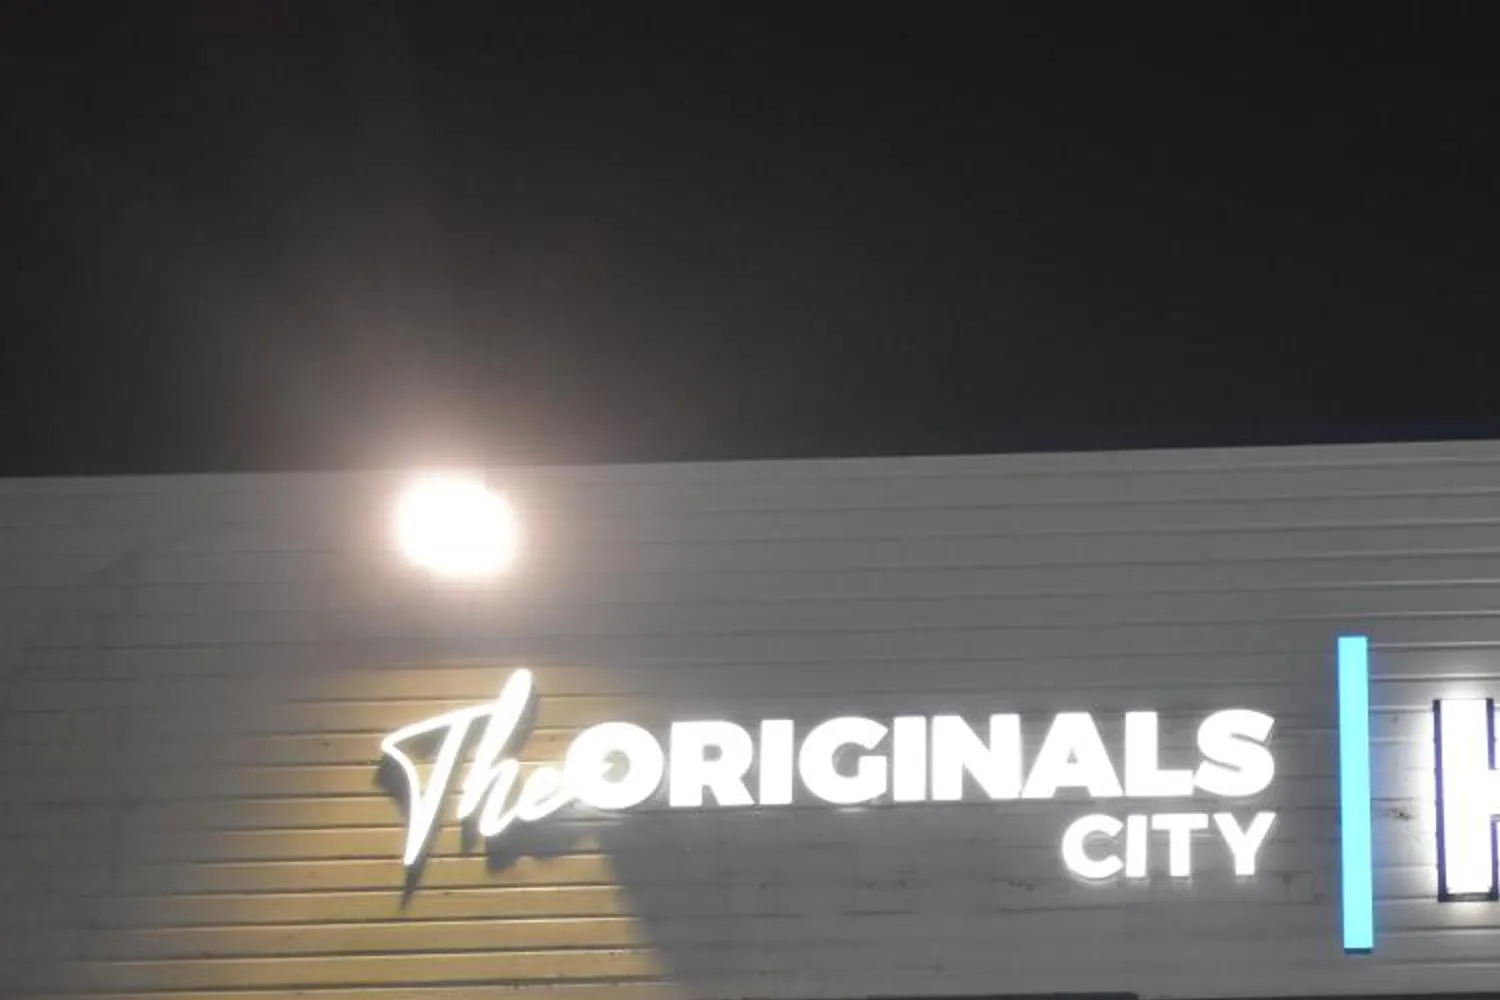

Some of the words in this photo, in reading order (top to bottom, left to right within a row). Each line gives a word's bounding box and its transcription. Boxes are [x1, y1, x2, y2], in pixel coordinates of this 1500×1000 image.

[379, 667, 578, 868] The
[564, 708, 1276, 810] ORIGINALS
[1061, 811, 1277, 879] CITY
